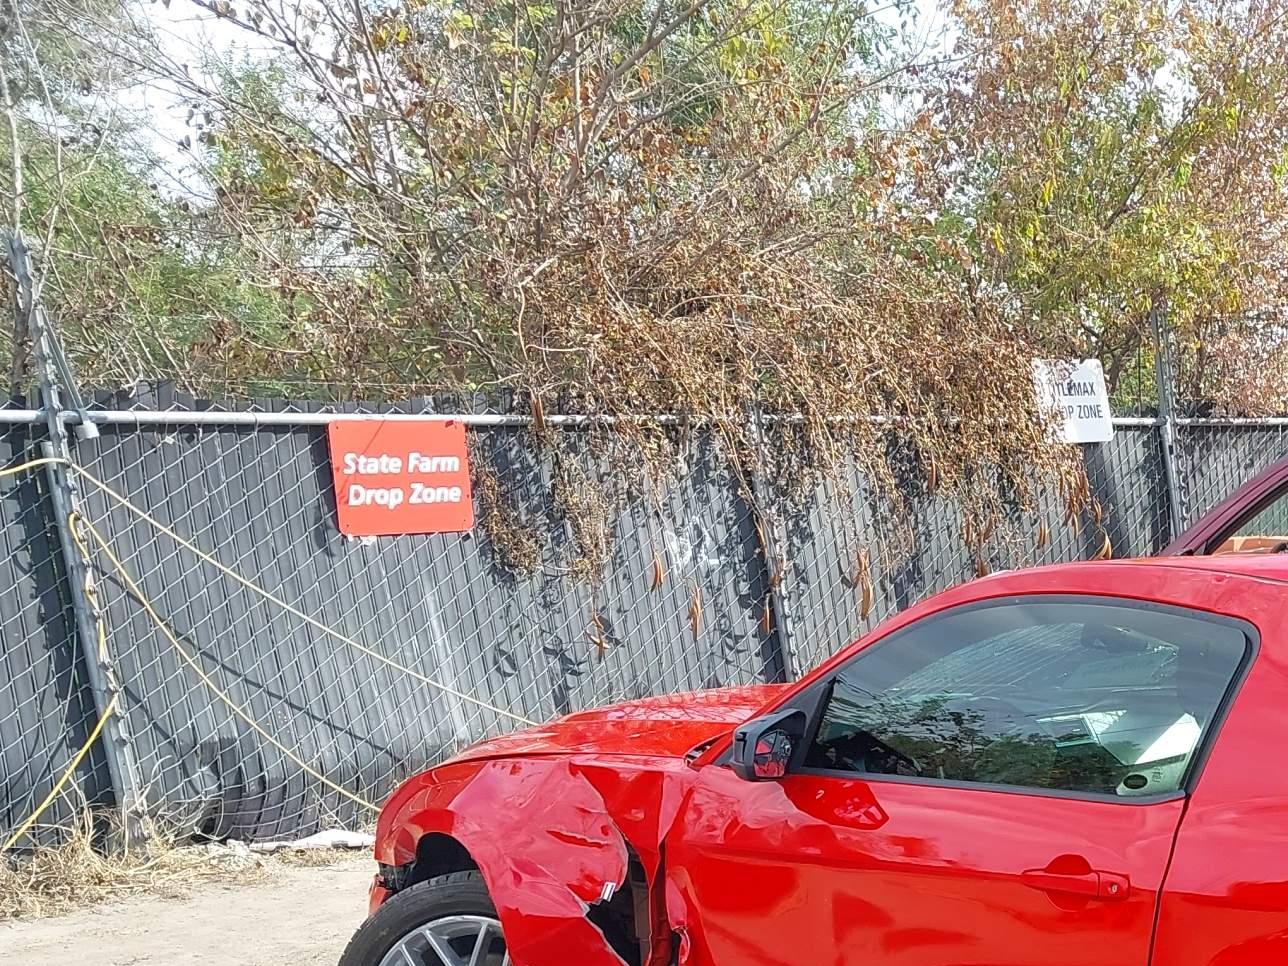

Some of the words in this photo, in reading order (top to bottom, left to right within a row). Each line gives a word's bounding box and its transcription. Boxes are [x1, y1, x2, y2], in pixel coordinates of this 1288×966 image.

[1077, 404, 1103, 419] ZONE
[342, 452, 402, 475] State
[408, 452, 460, 474] Farm
[348, 484, 404, 510] Drop
[408, 482, 462, 505] Zone
